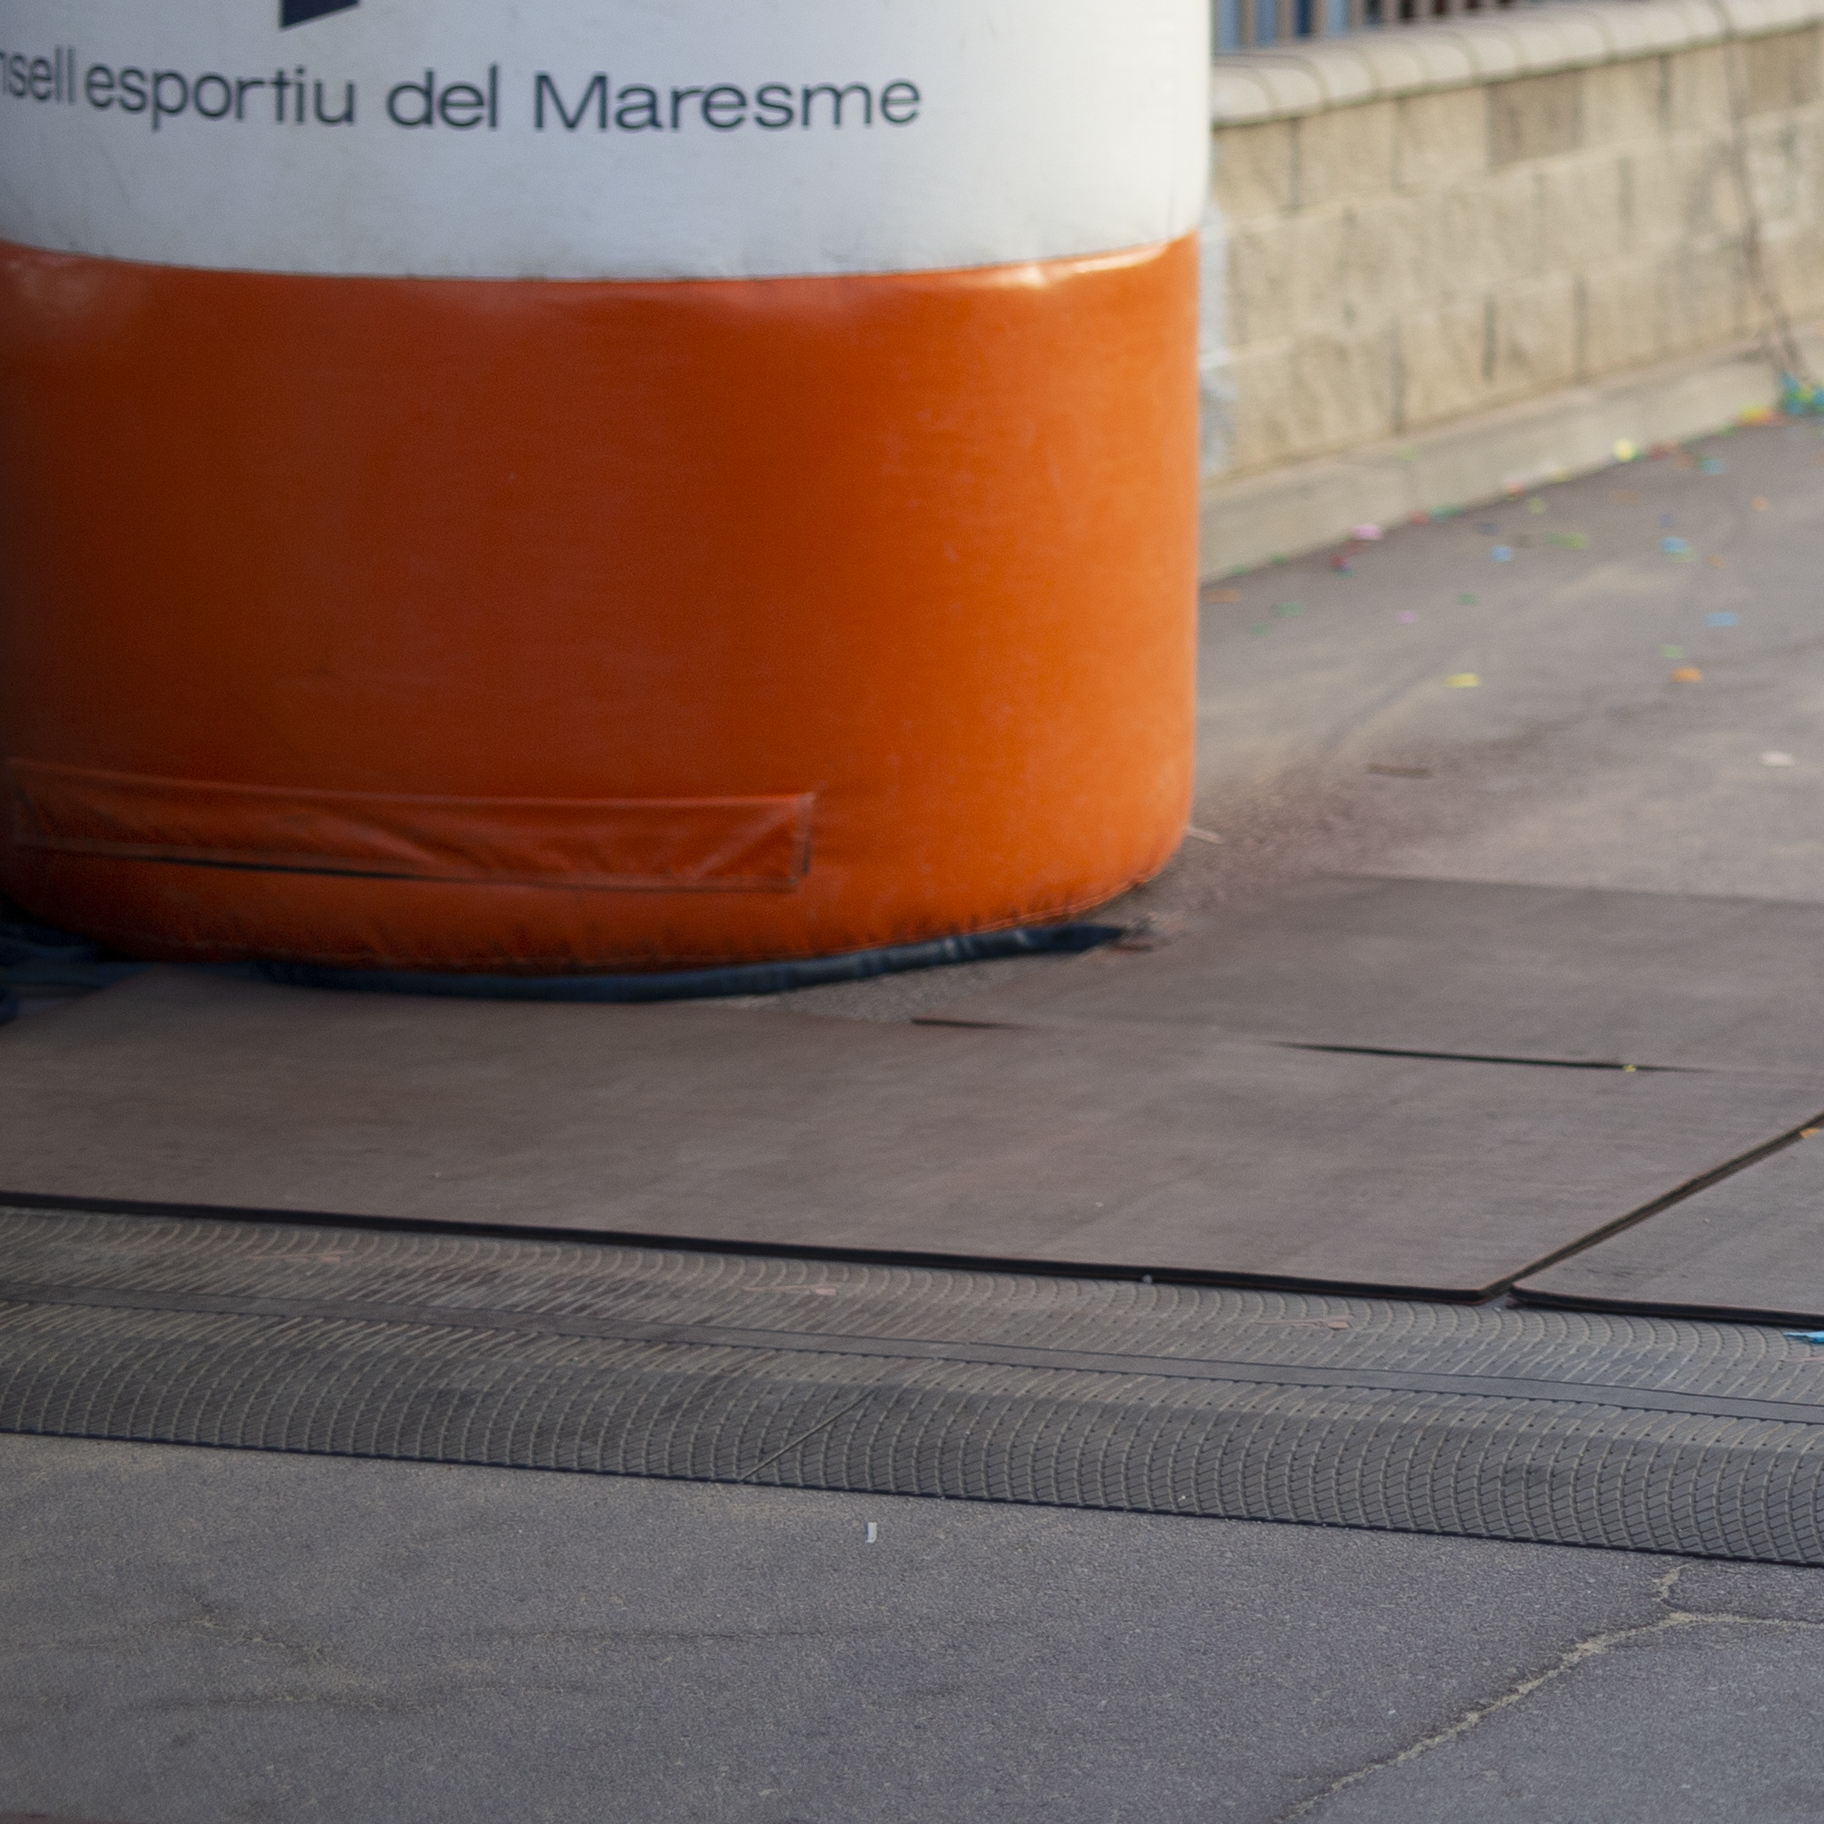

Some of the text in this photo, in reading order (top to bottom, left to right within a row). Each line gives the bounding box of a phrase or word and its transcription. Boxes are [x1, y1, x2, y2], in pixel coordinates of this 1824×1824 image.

[84, 61, 357, 133] esportiu
[385, 62, 499, 132] del
[533, 73, 922, 133] Maresme
